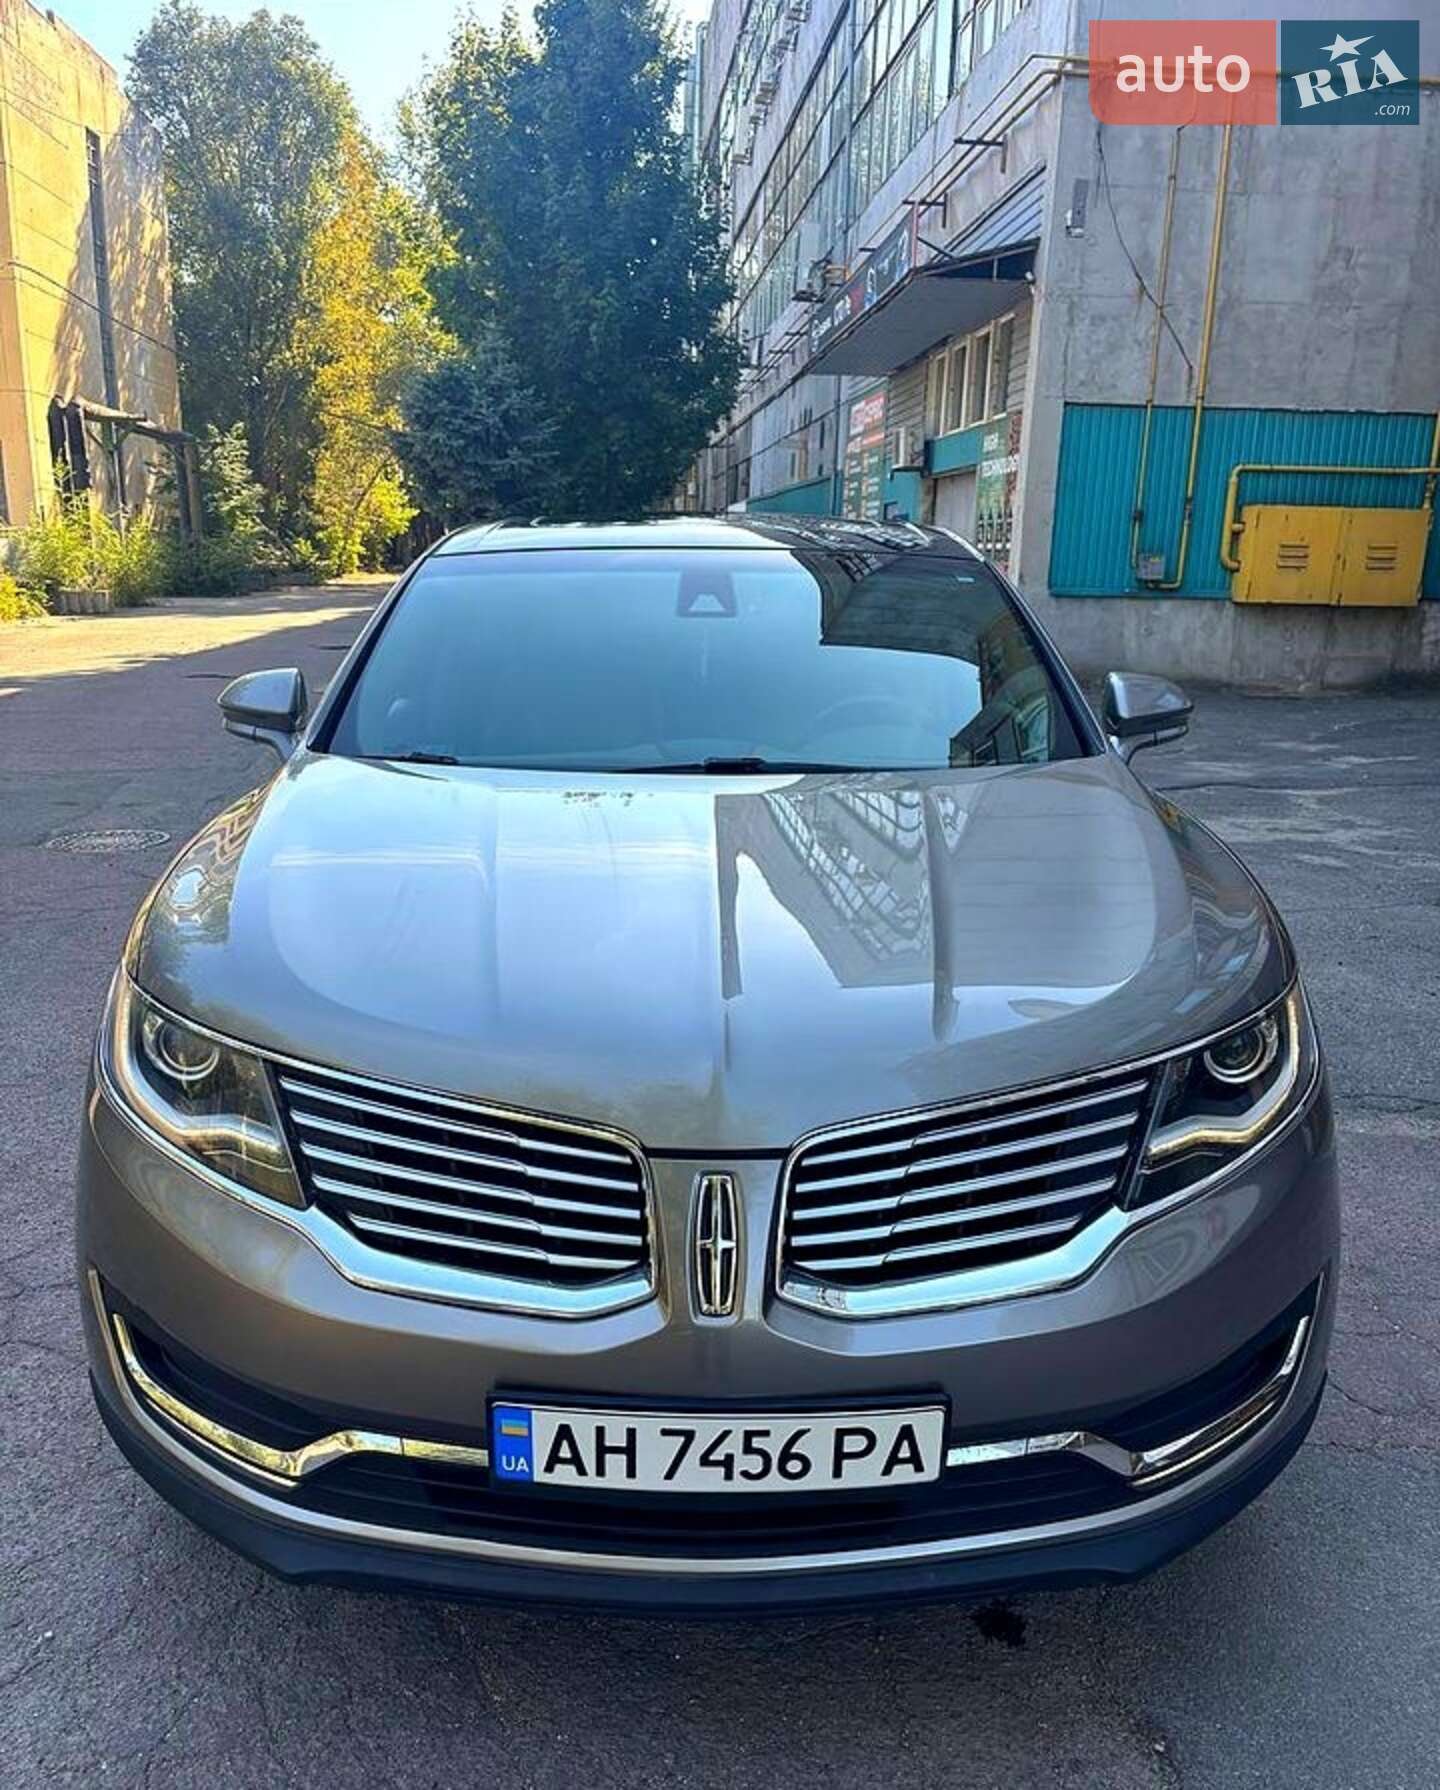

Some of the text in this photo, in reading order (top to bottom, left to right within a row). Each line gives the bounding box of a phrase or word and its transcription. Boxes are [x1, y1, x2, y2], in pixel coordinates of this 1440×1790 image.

[502, 1455, 529, 1473] UA
[543, 1423, 925, 1481] AH 7456 PA
